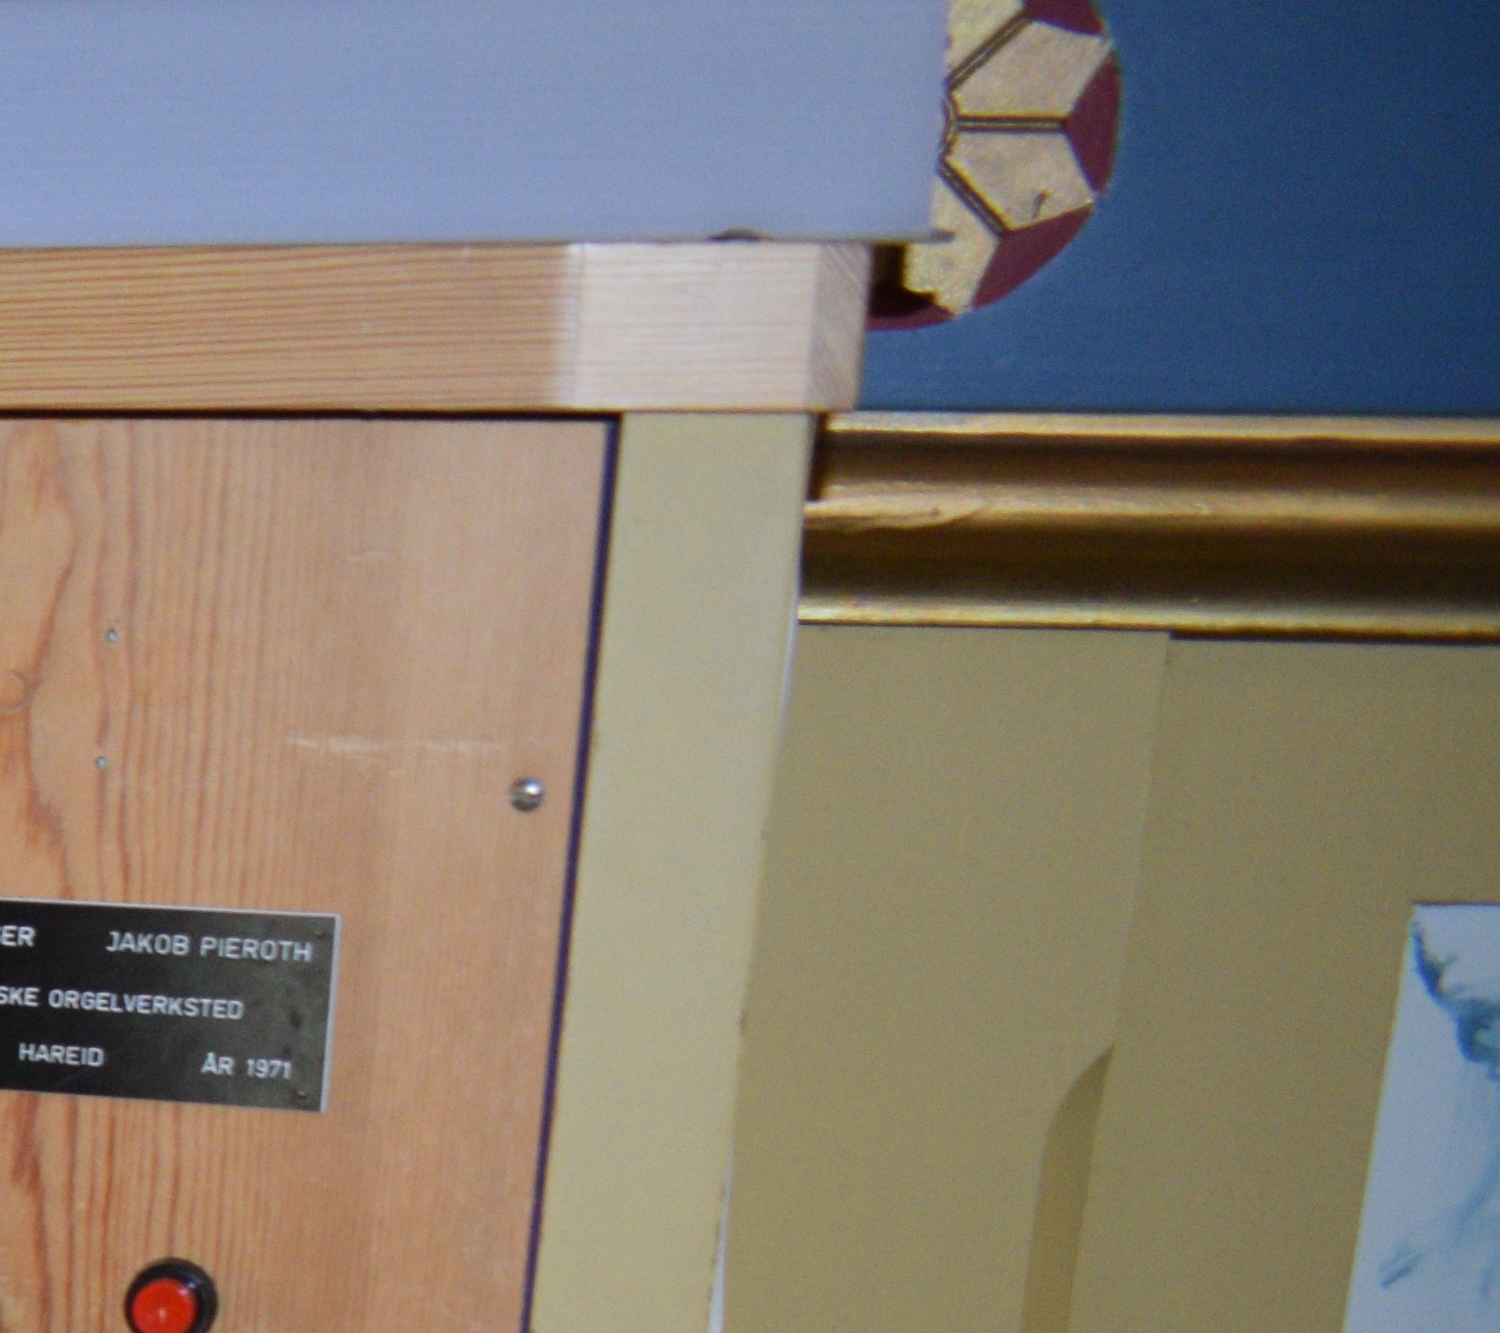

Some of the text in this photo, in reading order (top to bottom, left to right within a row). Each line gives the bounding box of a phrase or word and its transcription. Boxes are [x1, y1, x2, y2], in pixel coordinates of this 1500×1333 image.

[106, 930, 190, 955] JAKOB
[200, 936, 312, 963] PIEROTH
[48, 988, 244, 1020] ORGELVERKSTED
[19, 1042, 105, 1067] HAREID
[201, 1051, 234, 1076] ÅR
[246, 1057, 292, 1080] 1971
